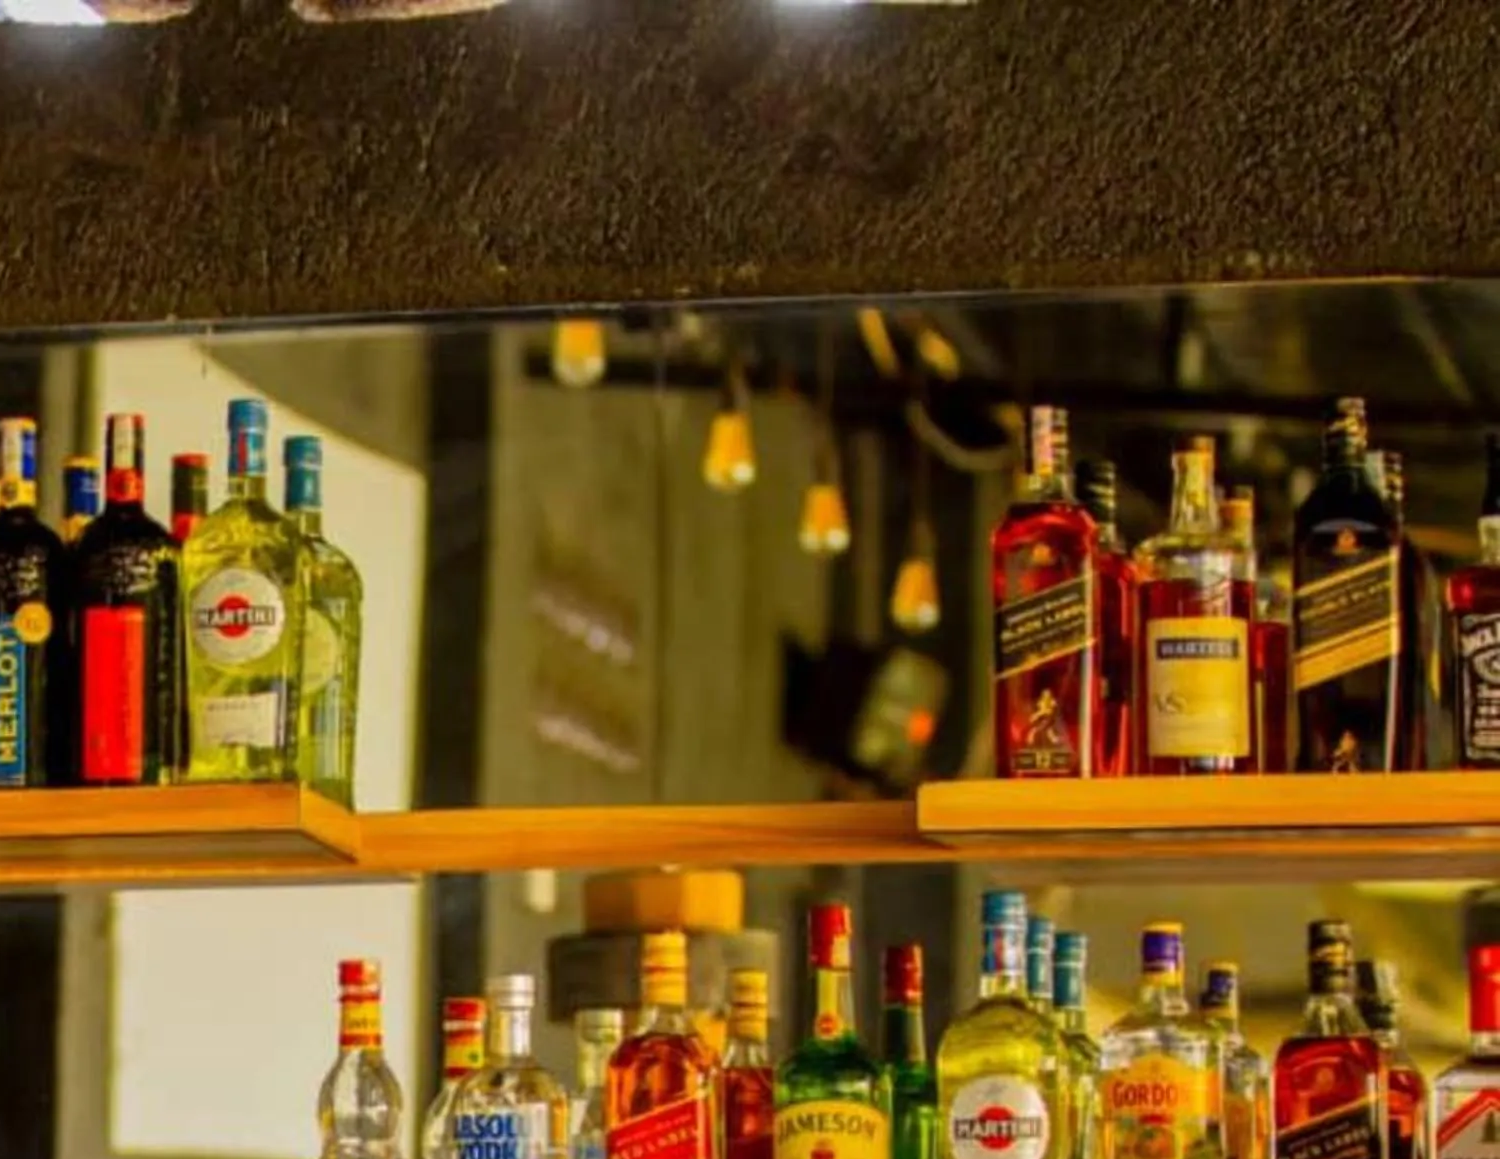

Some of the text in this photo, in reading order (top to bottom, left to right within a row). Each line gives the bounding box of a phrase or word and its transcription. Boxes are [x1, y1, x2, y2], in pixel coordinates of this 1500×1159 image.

[195, 605, 277, 631] MARTINI
[778, 1112, 877, 1146] JAMESON
[954, 1117, 1042, 1140] MARTINI
